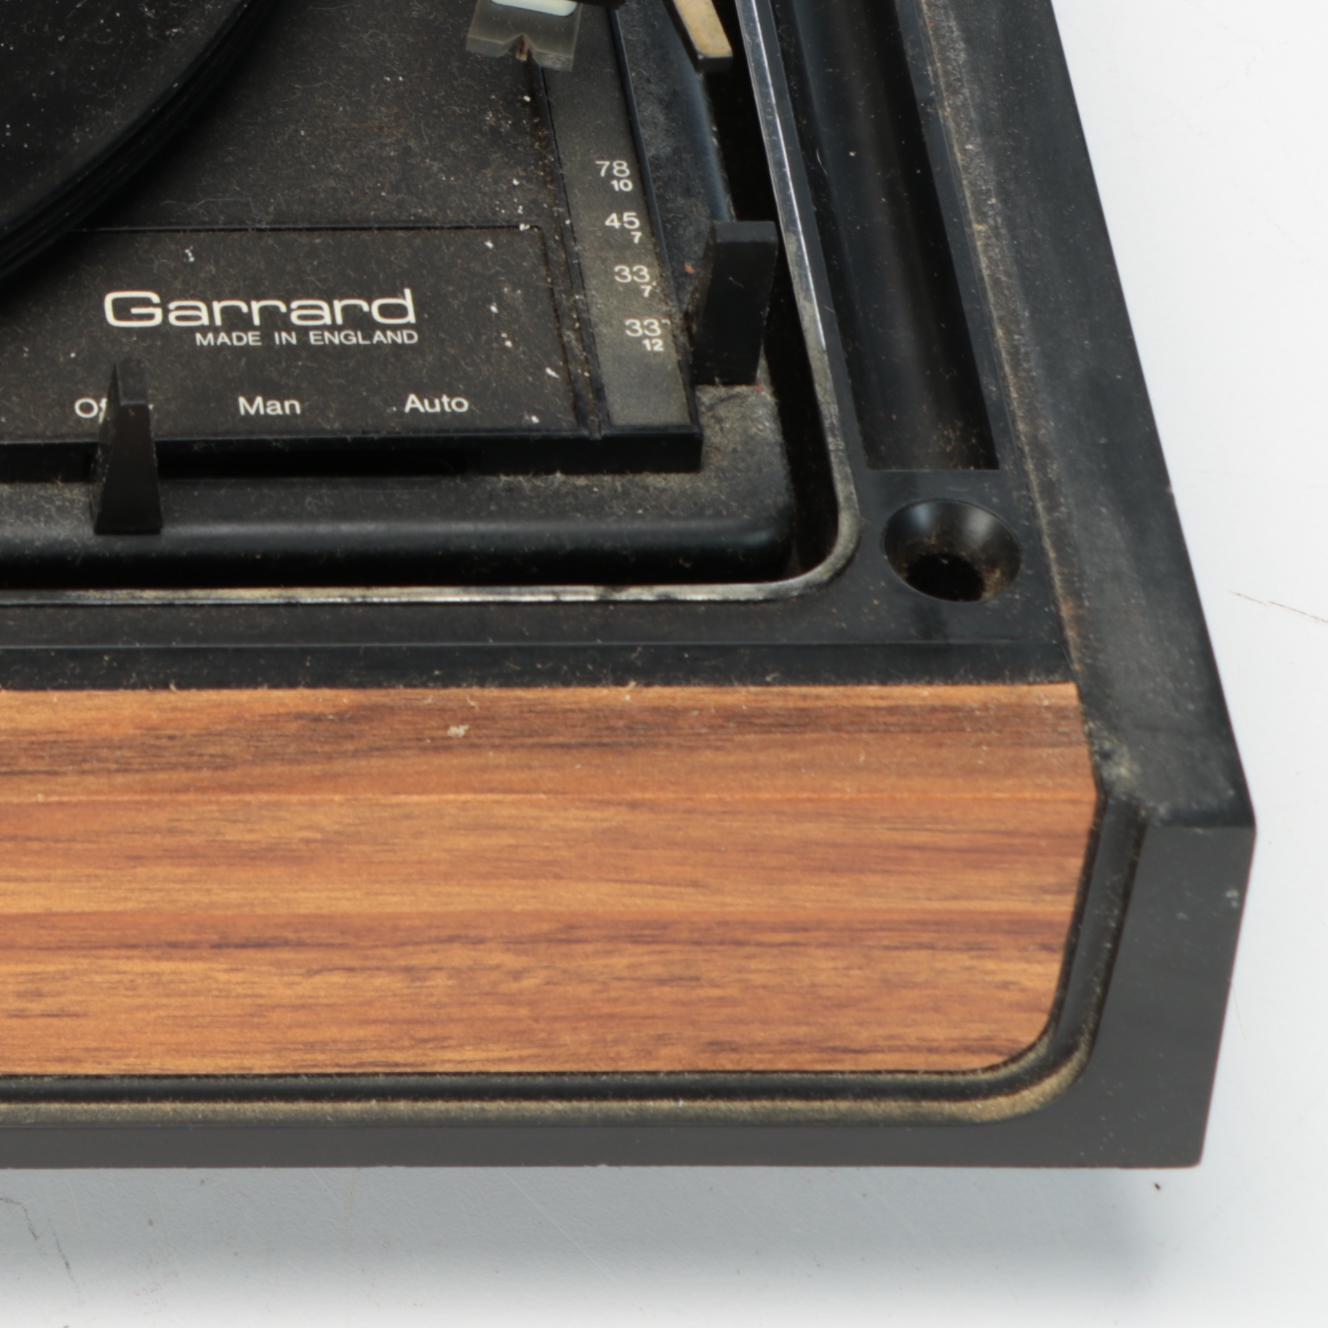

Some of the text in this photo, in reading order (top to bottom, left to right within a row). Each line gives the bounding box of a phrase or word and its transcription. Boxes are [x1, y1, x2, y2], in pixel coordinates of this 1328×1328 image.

[595, 160, 630, 178] 78
[611, 179, 633, 192] 10
[604, 212, 640, 229] 45
[630, 231, 642, 244] 7
[613, 265, 650, 283] 33
[640, 284, 652, 298] 7
[104, 288, 416, 327] Garrard
[195, 329, 419, 347] MADE IN ENGLAND
[642, 338, 664, 352] 12
[239, 396, 301, 416] Man
[405, 393, 469, 414] Auto
